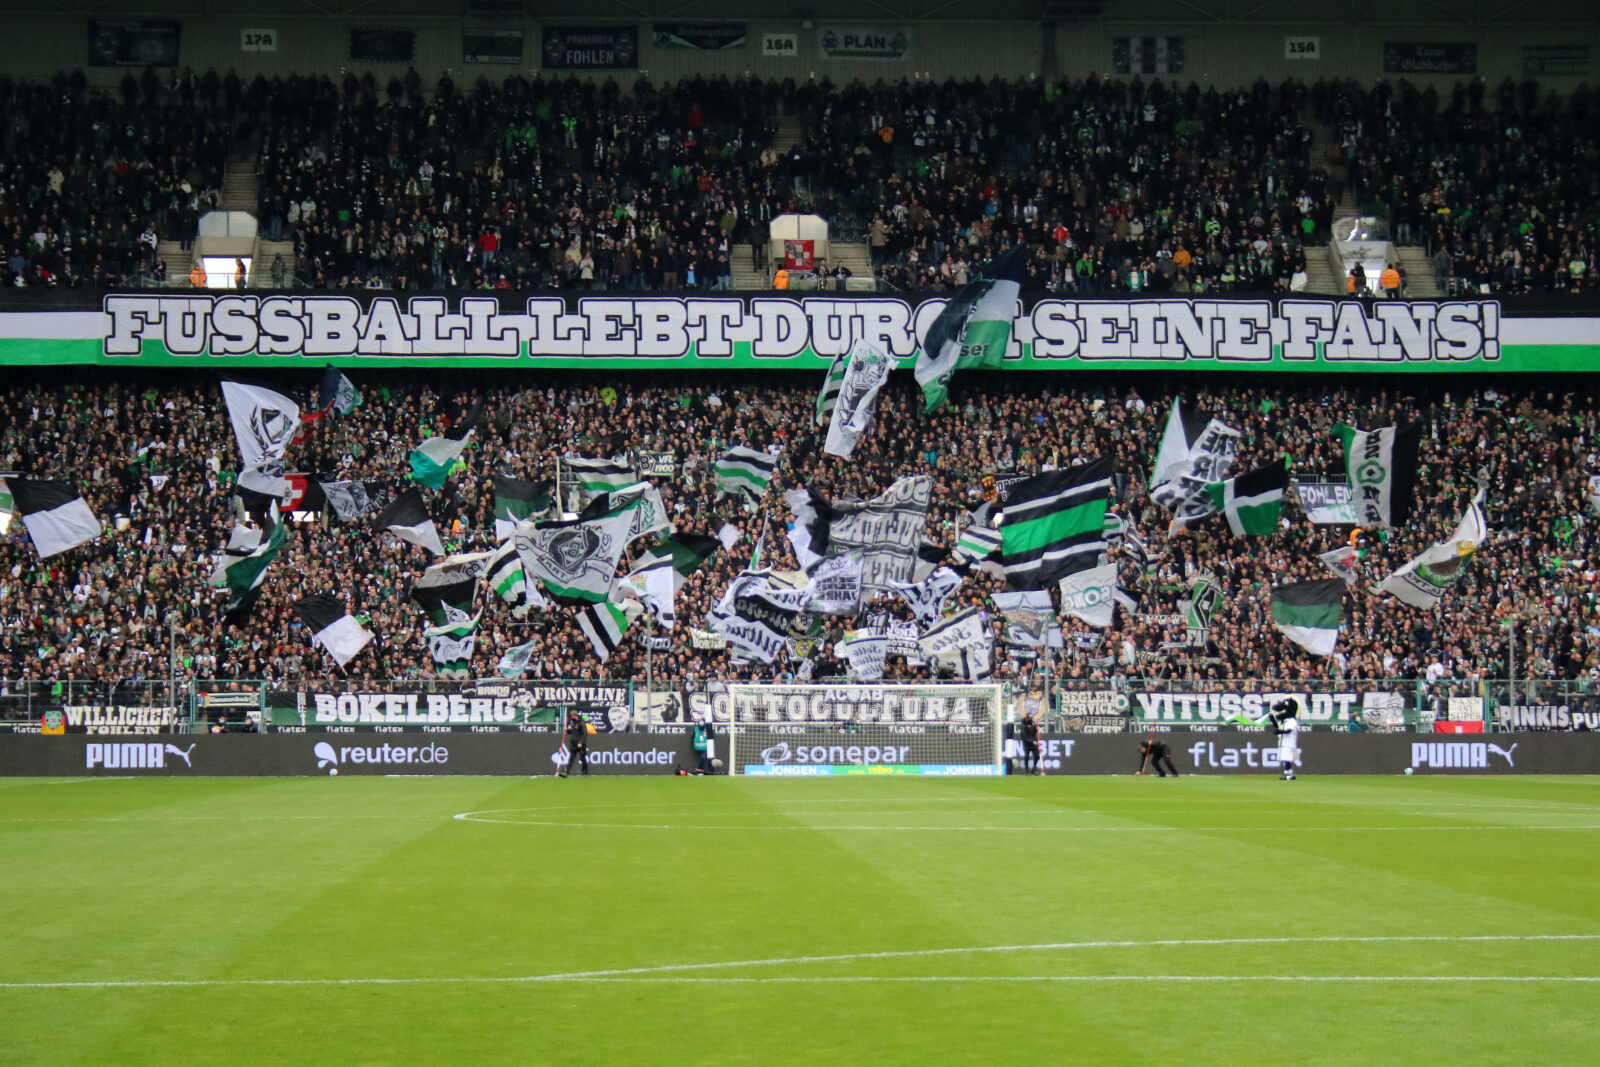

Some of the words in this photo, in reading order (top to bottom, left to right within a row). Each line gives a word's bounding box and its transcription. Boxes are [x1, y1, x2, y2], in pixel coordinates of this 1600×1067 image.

[245, 34, 272, 45] 17A
[766, 39, 793, 50] 16A
[844, 35, 885, 49] PLAN
[1289, 42, 1315, 53] 15A
[566, 50, 614, 64] FOHLEN
[105, 295, 519, 356] FUSSBALL
[528, 297, 742, 357] LEBT
[1034, 301, 1271, 360] SEINE
[1280, 301, 1500, 361] FANS!
[655, 464, 674, 472] 1900
[1298, 486, 1353, 505] FOHLEN
[534, 687, 626, 703] FRONTLINE
[1061, 691, 1117, 703] BEGLEIT
[63, 705, 178, 726] WILLICHER
[1061, 703, 1116, 716] SERVICE
[86, 743, 164, 768] PUMA
[341, 742, 448, 763] reuter.de
[795, 746, 910, 764] sonepar
[1412, 743, 1487, 768] PUMA
[769, 766, 817, 775] JONGEN
[943, 766, 992, 775] JONGEN
